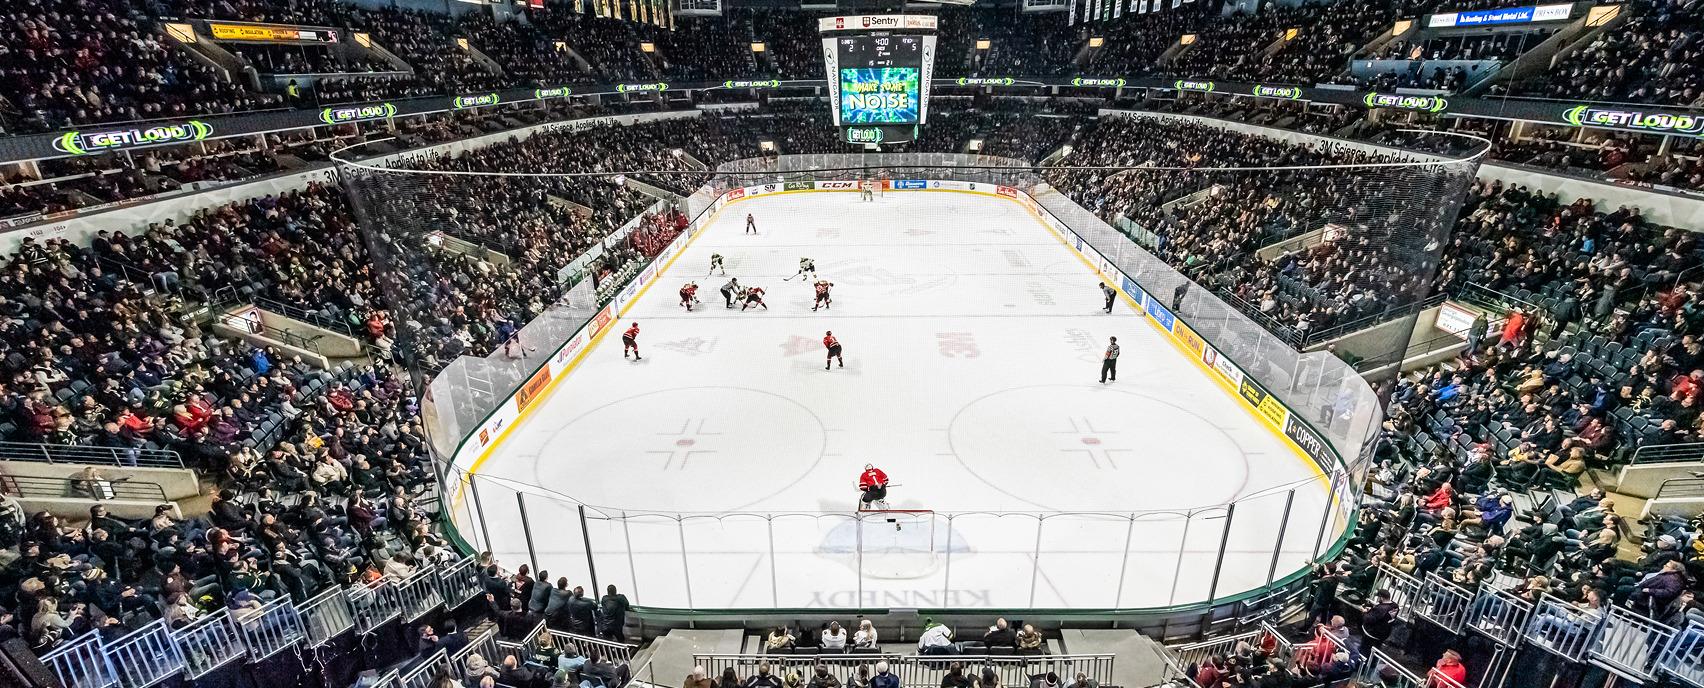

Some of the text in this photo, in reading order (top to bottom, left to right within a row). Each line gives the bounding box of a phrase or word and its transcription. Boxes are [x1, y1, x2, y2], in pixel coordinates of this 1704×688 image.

[871, 16, 899, 26] Sentry
[875, 38, 889, 46] 4:00
[831, 66, 839, 110] NAVIGATOR
[1261, 87, 1291, 97] GET LOUD
[463, 95, 491, 106] GET LOUD
[849, 93, 909, 110] NOISE
[1378, 95, 1428, 108] GET LOUD
[337, 106, 382, 120] GET LOUD
[1592, 110, 1693, 129] GET LOUD
[92, 125, 184, 147] GET LOUD
[1319, 139, 1333, 153] 3M
[764, 183, 776, 191] SN
[1296, 426, 1321, 458] COPPER
[804, 589, 993, 608] KENNEDY
